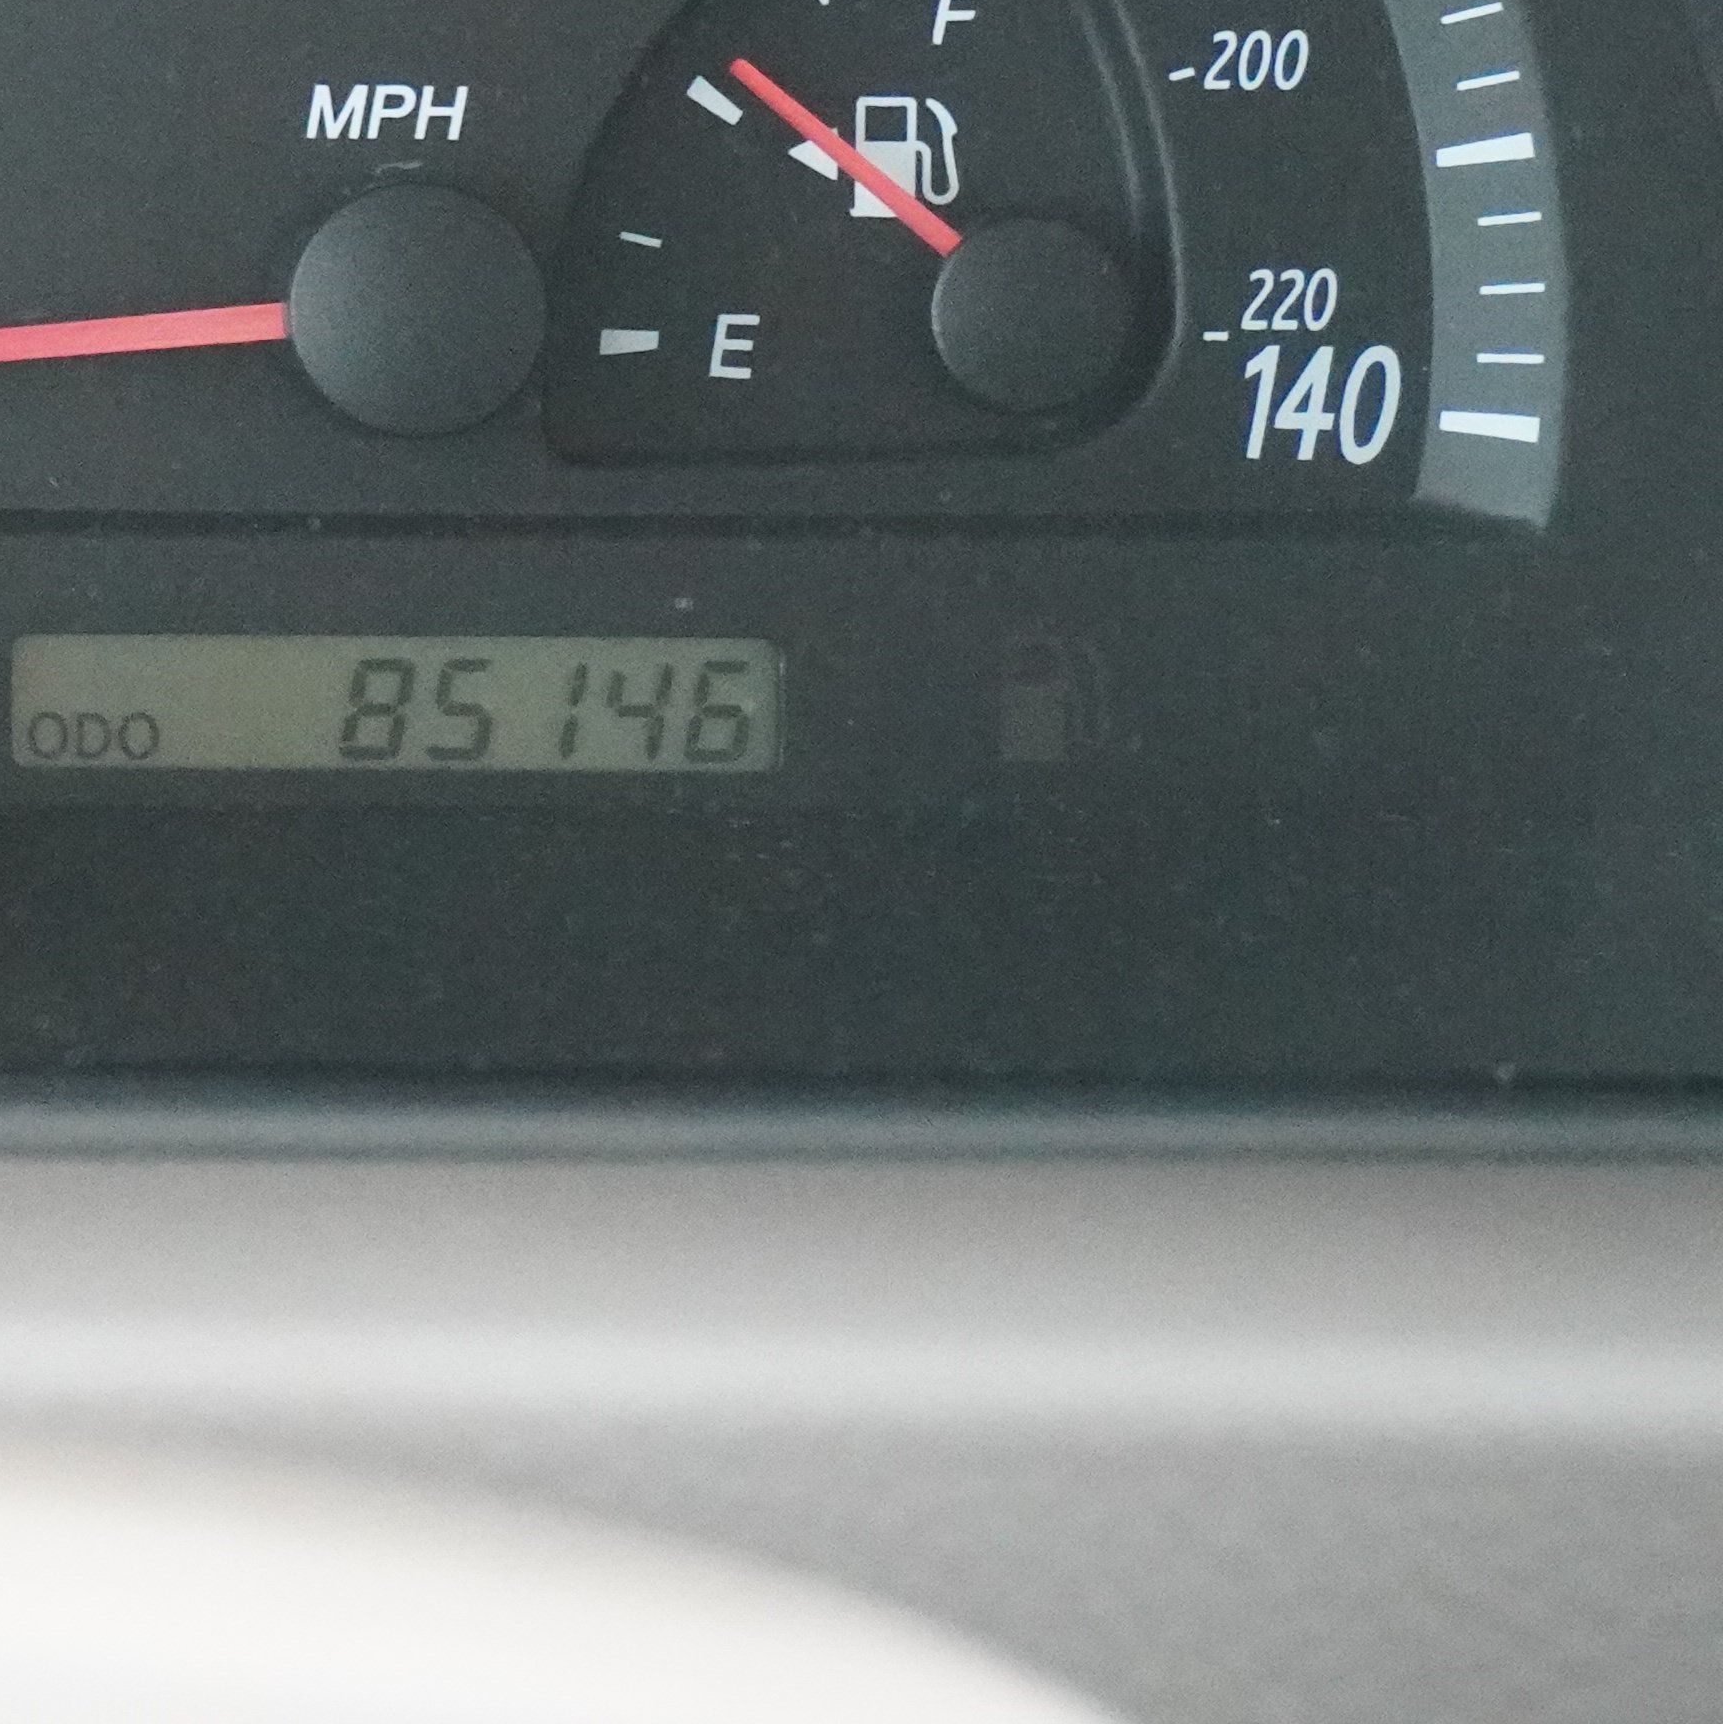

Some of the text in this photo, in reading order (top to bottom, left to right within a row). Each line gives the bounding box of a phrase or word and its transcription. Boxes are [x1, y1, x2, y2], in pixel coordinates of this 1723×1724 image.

[1204, 30, 1308, 90] 200
[307, 85, 468, 140] MPH
[1241, 269, 1337, 331] 220
[710, 314, 760, 379] E
[1245, 345, 1400, 464] 140
[26, 657, 751, 764] ODO 85146
